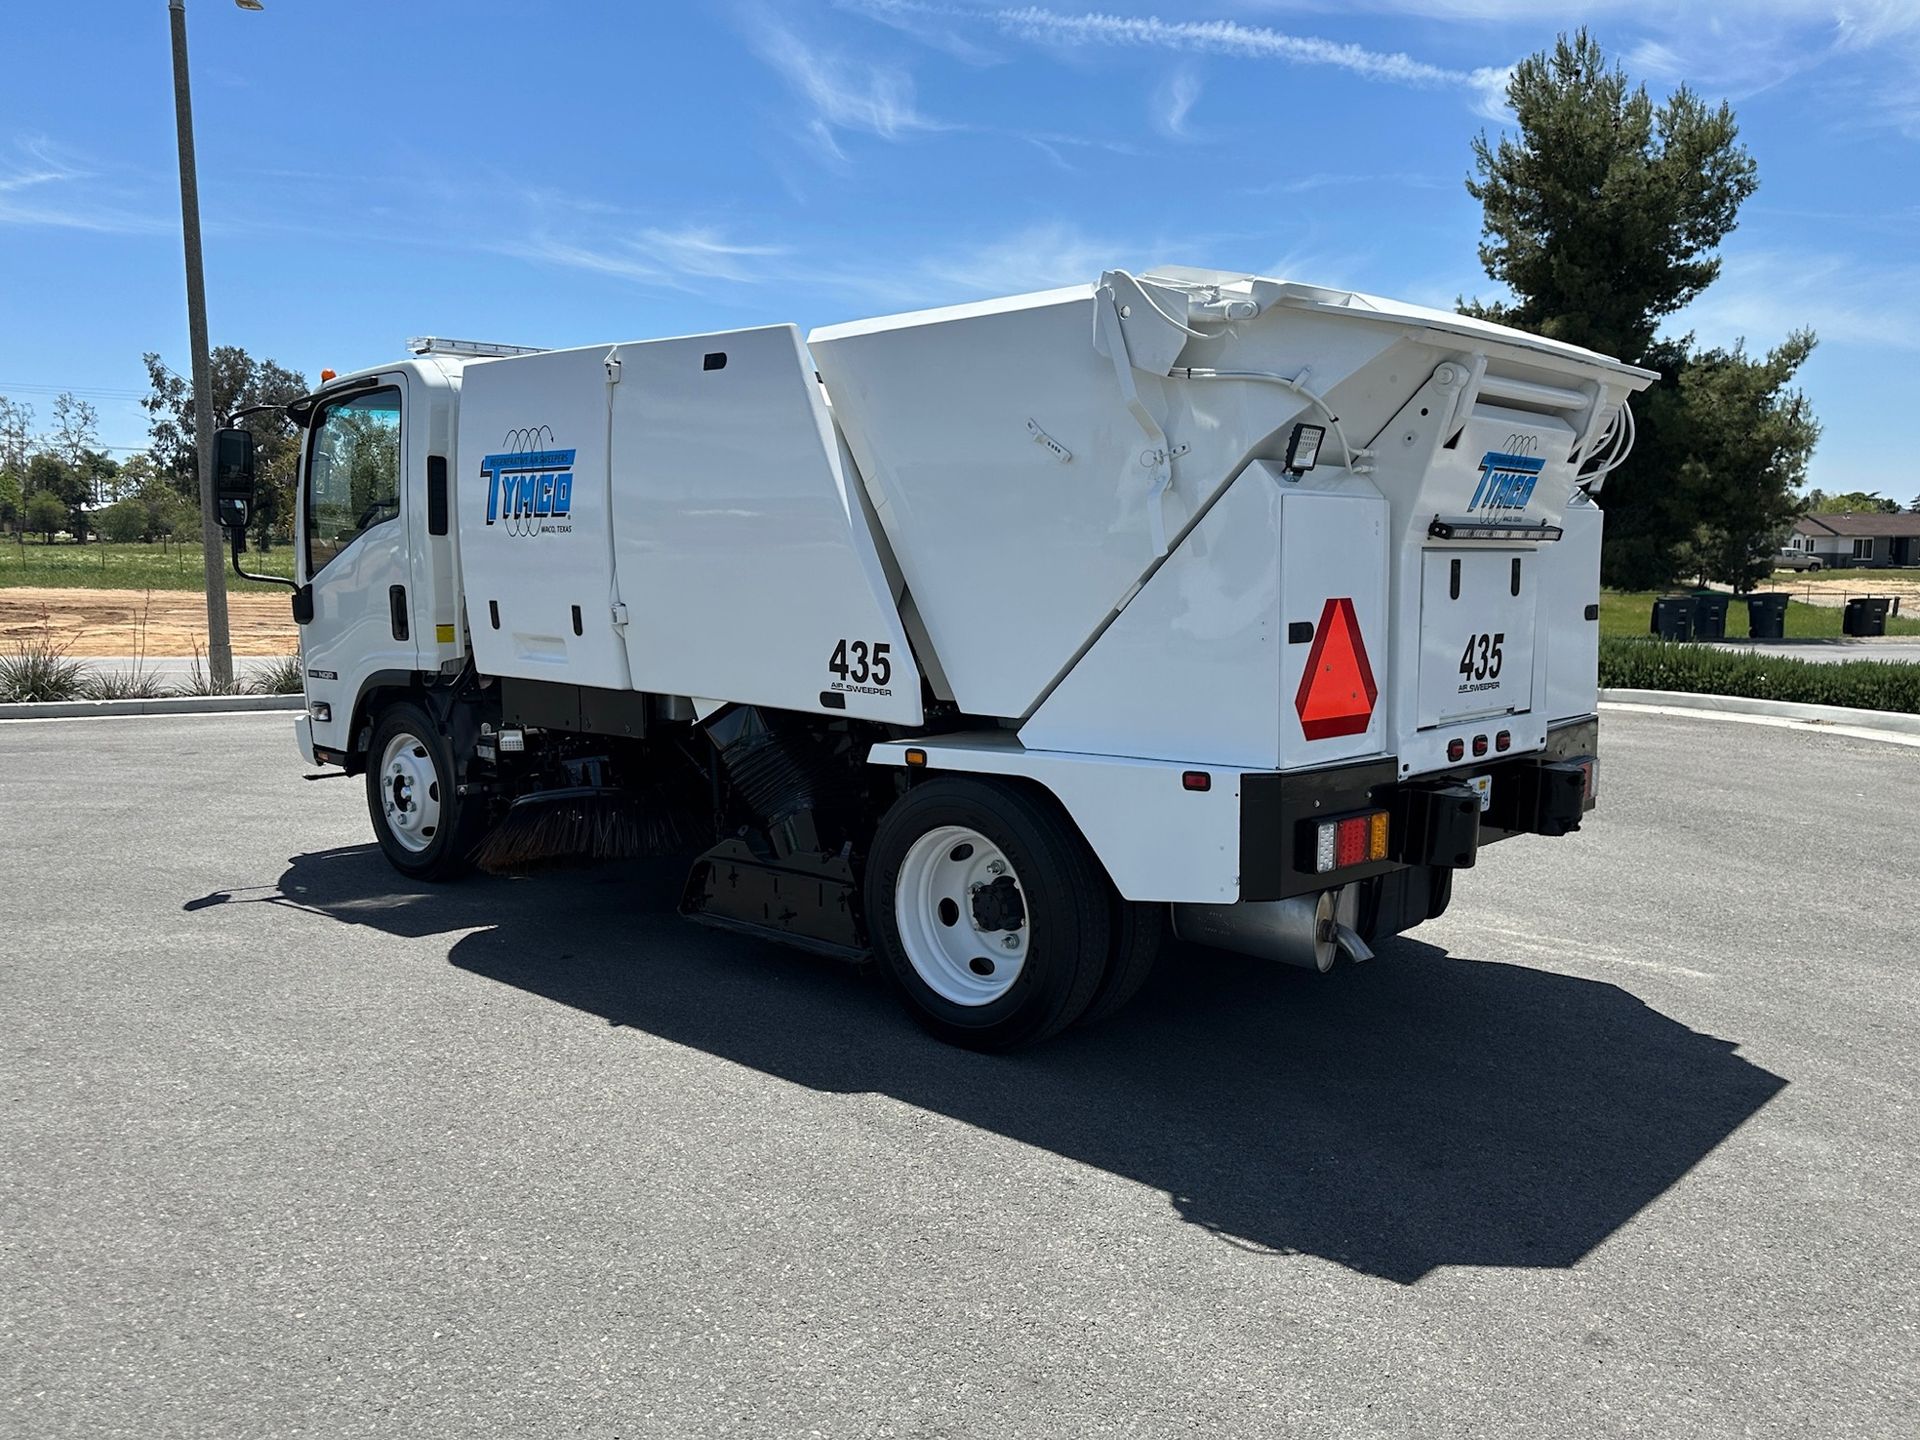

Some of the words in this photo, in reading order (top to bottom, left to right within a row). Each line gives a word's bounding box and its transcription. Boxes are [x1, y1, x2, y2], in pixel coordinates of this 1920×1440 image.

[480, 449, 577, 525] TYMCO
[1467, 451, 1547, 512] TYMCO
[556, 525, 572, 533] TEXAS
[829, 639, 891, 686] 435
[1459, 633, 1505, 681] 435
[846, 685, 892, 696] SWEEPER
[1469, 681, 1500, 692] SWEEPER
